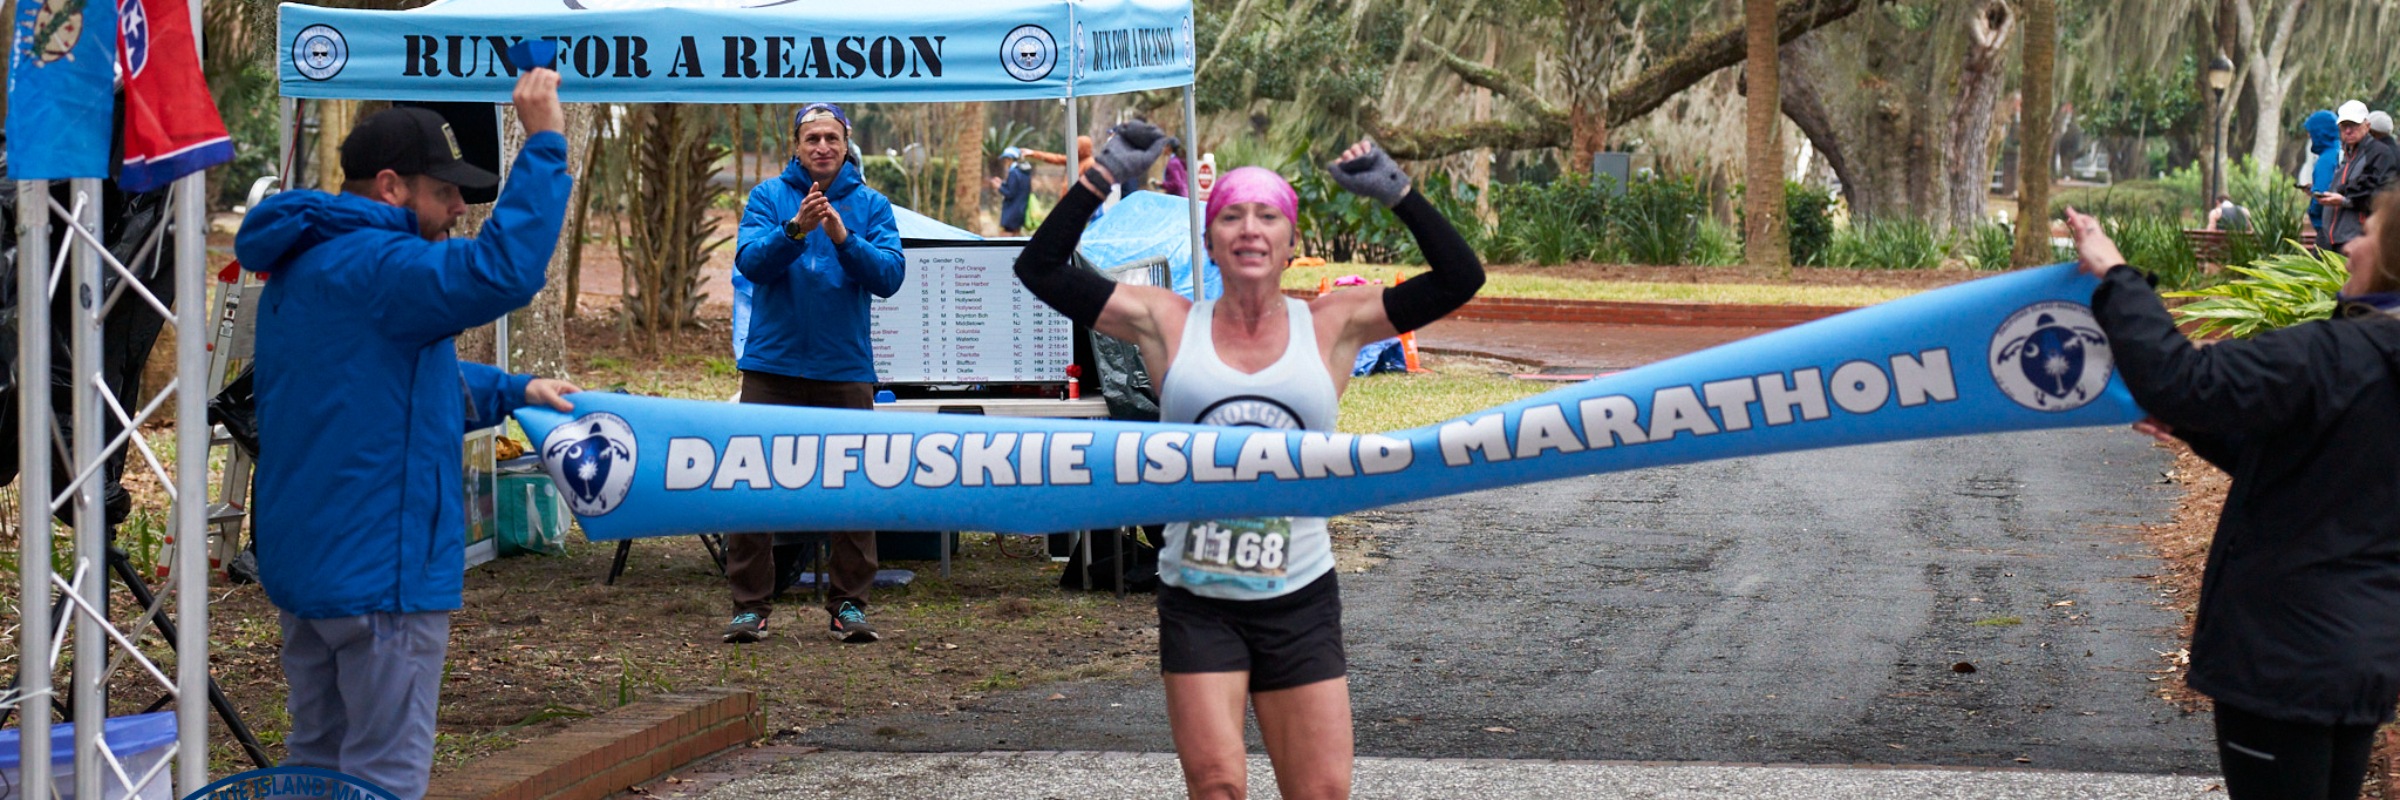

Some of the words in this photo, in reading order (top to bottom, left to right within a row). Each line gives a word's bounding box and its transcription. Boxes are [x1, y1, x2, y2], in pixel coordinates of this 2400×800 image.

[403, 35, 523, 78] RUN
[667, 35, 704, 78] A
[722, 36, 946, 79] REASON
[1092, 31, 1111, 72] RUN
[1112, 28, 1131, 69] FOR
[1132, 27, 1139, 67] A
[1138, 27, 1176, 67] REASON
[665, 431, 1094, 490] DAUFUSKIE
[1114, 430, 1415, 485] ISLAND
[1438, 346, 1958, 468] MARATHON
[1192, 524, 1284, 569] 1168
